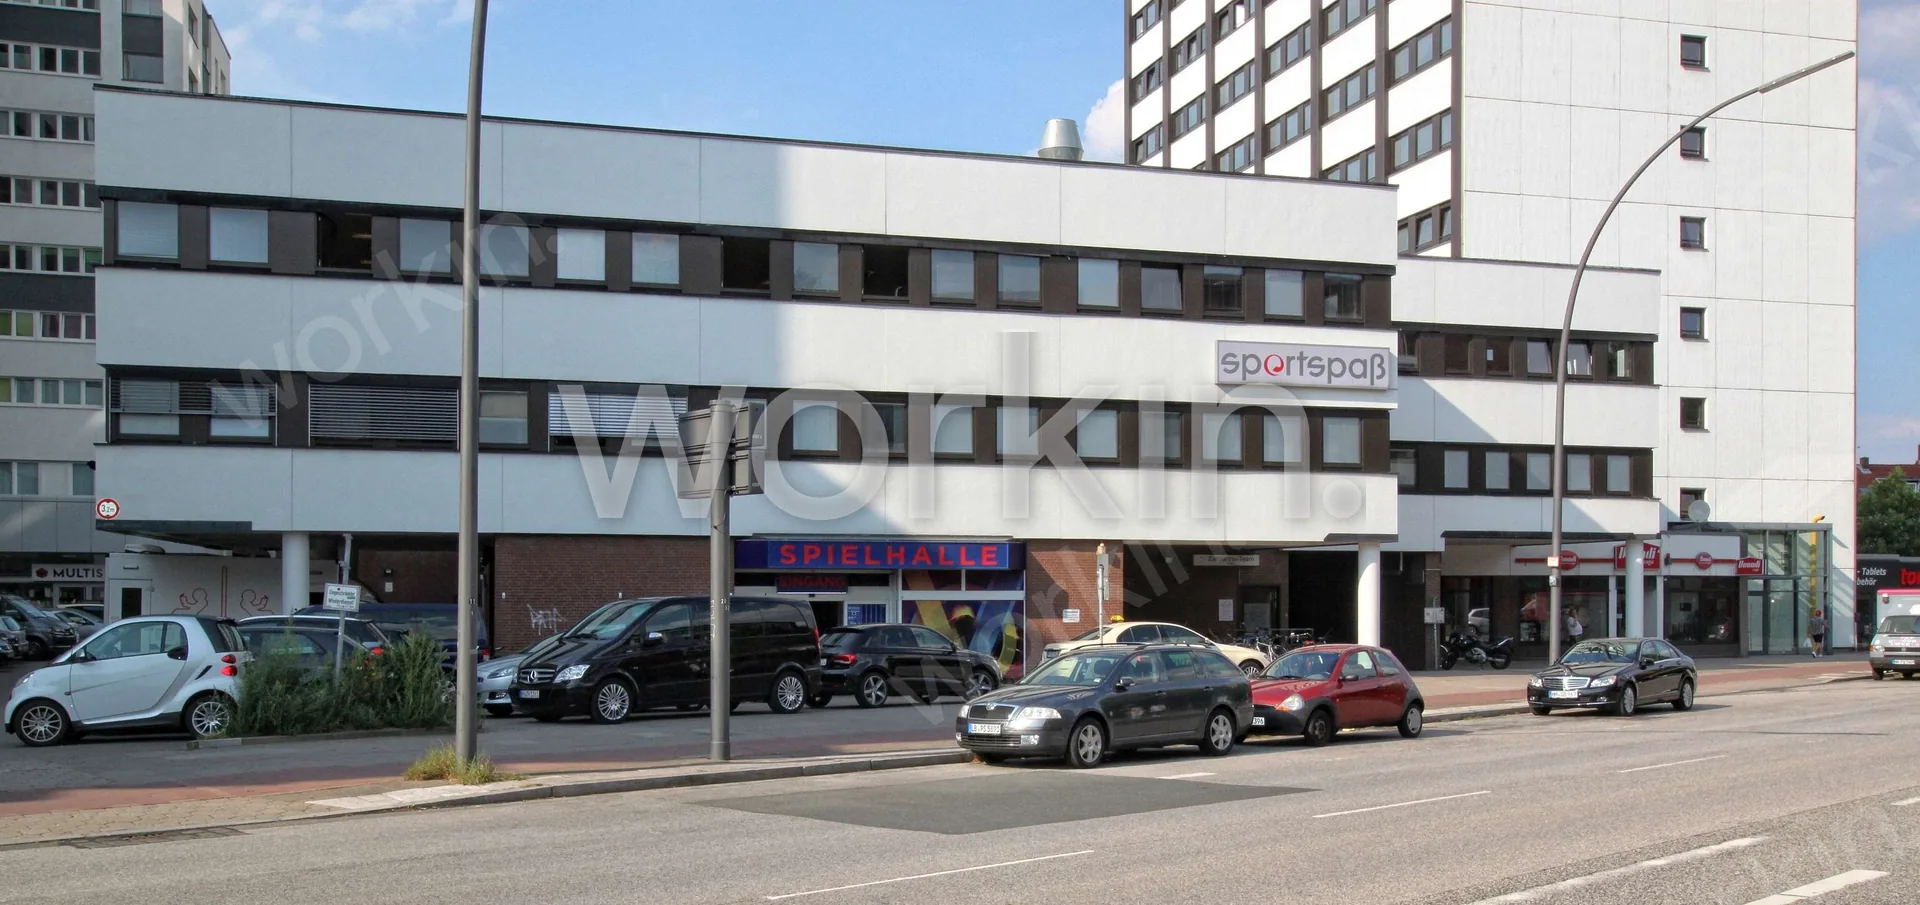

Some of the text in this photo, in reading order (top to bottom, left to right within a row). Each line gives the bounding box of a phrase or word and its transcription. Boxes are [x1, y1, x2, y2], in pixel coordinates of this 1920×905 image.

[1221, 351, 1386, 386] sportspaß
[780, 544, 999, 566] SPIELHALLE
[1862, 567, 1887, 576] Tablets
[779, 576, 847, 588] EINGANG
